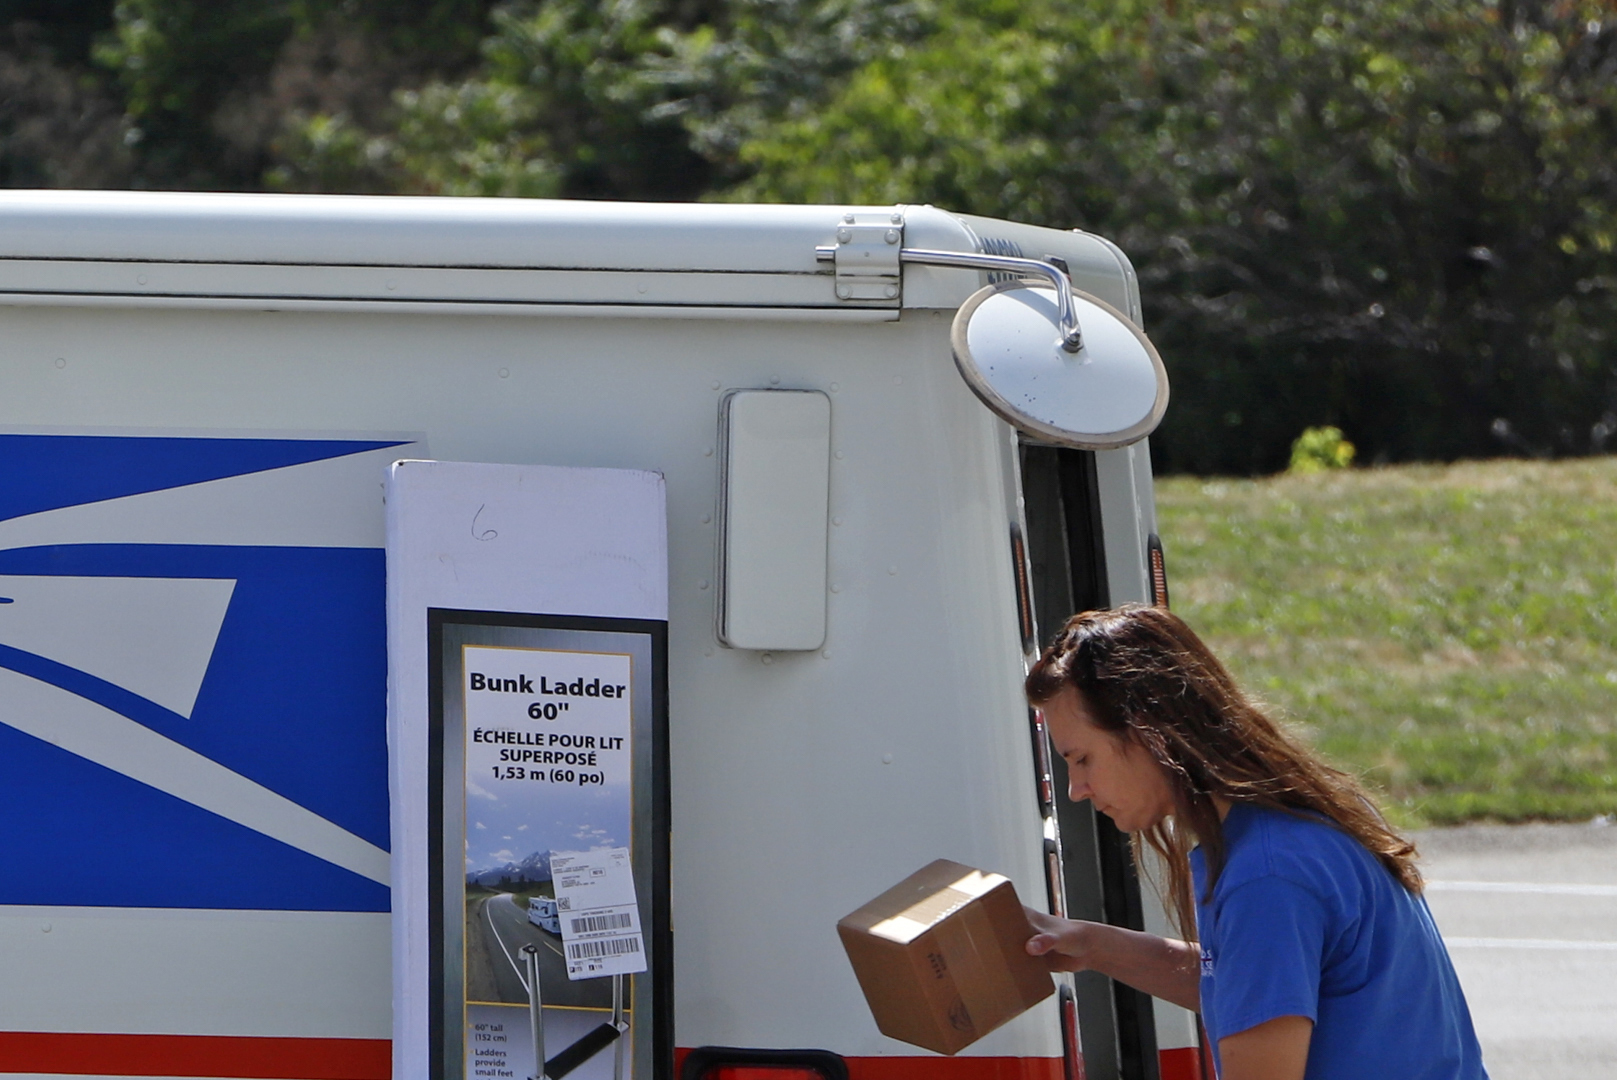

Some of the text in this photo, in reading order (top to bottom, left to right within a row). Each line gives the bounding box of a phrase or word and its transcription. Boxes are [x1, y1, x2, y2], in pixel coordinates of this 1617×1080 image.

[471, 504, 498, 541] 6
[470, 672, 626, 698] Bunk Ladder
[528, 702, 570, 720] 60"
[473, 728, 623, 751] ÉCHELLE POUR LIT
[500, 748, 597, 766] SUPERPOSÉ
[492, 766, 605, 786] 1,53 m (60 po)
[475, 1033, 507, 1042] (152 cm)
[475, 1049, 507, 1057] Ladders
[475, 1059, 506, 1067] provide
[498, 1069, 513, 1077] feet
